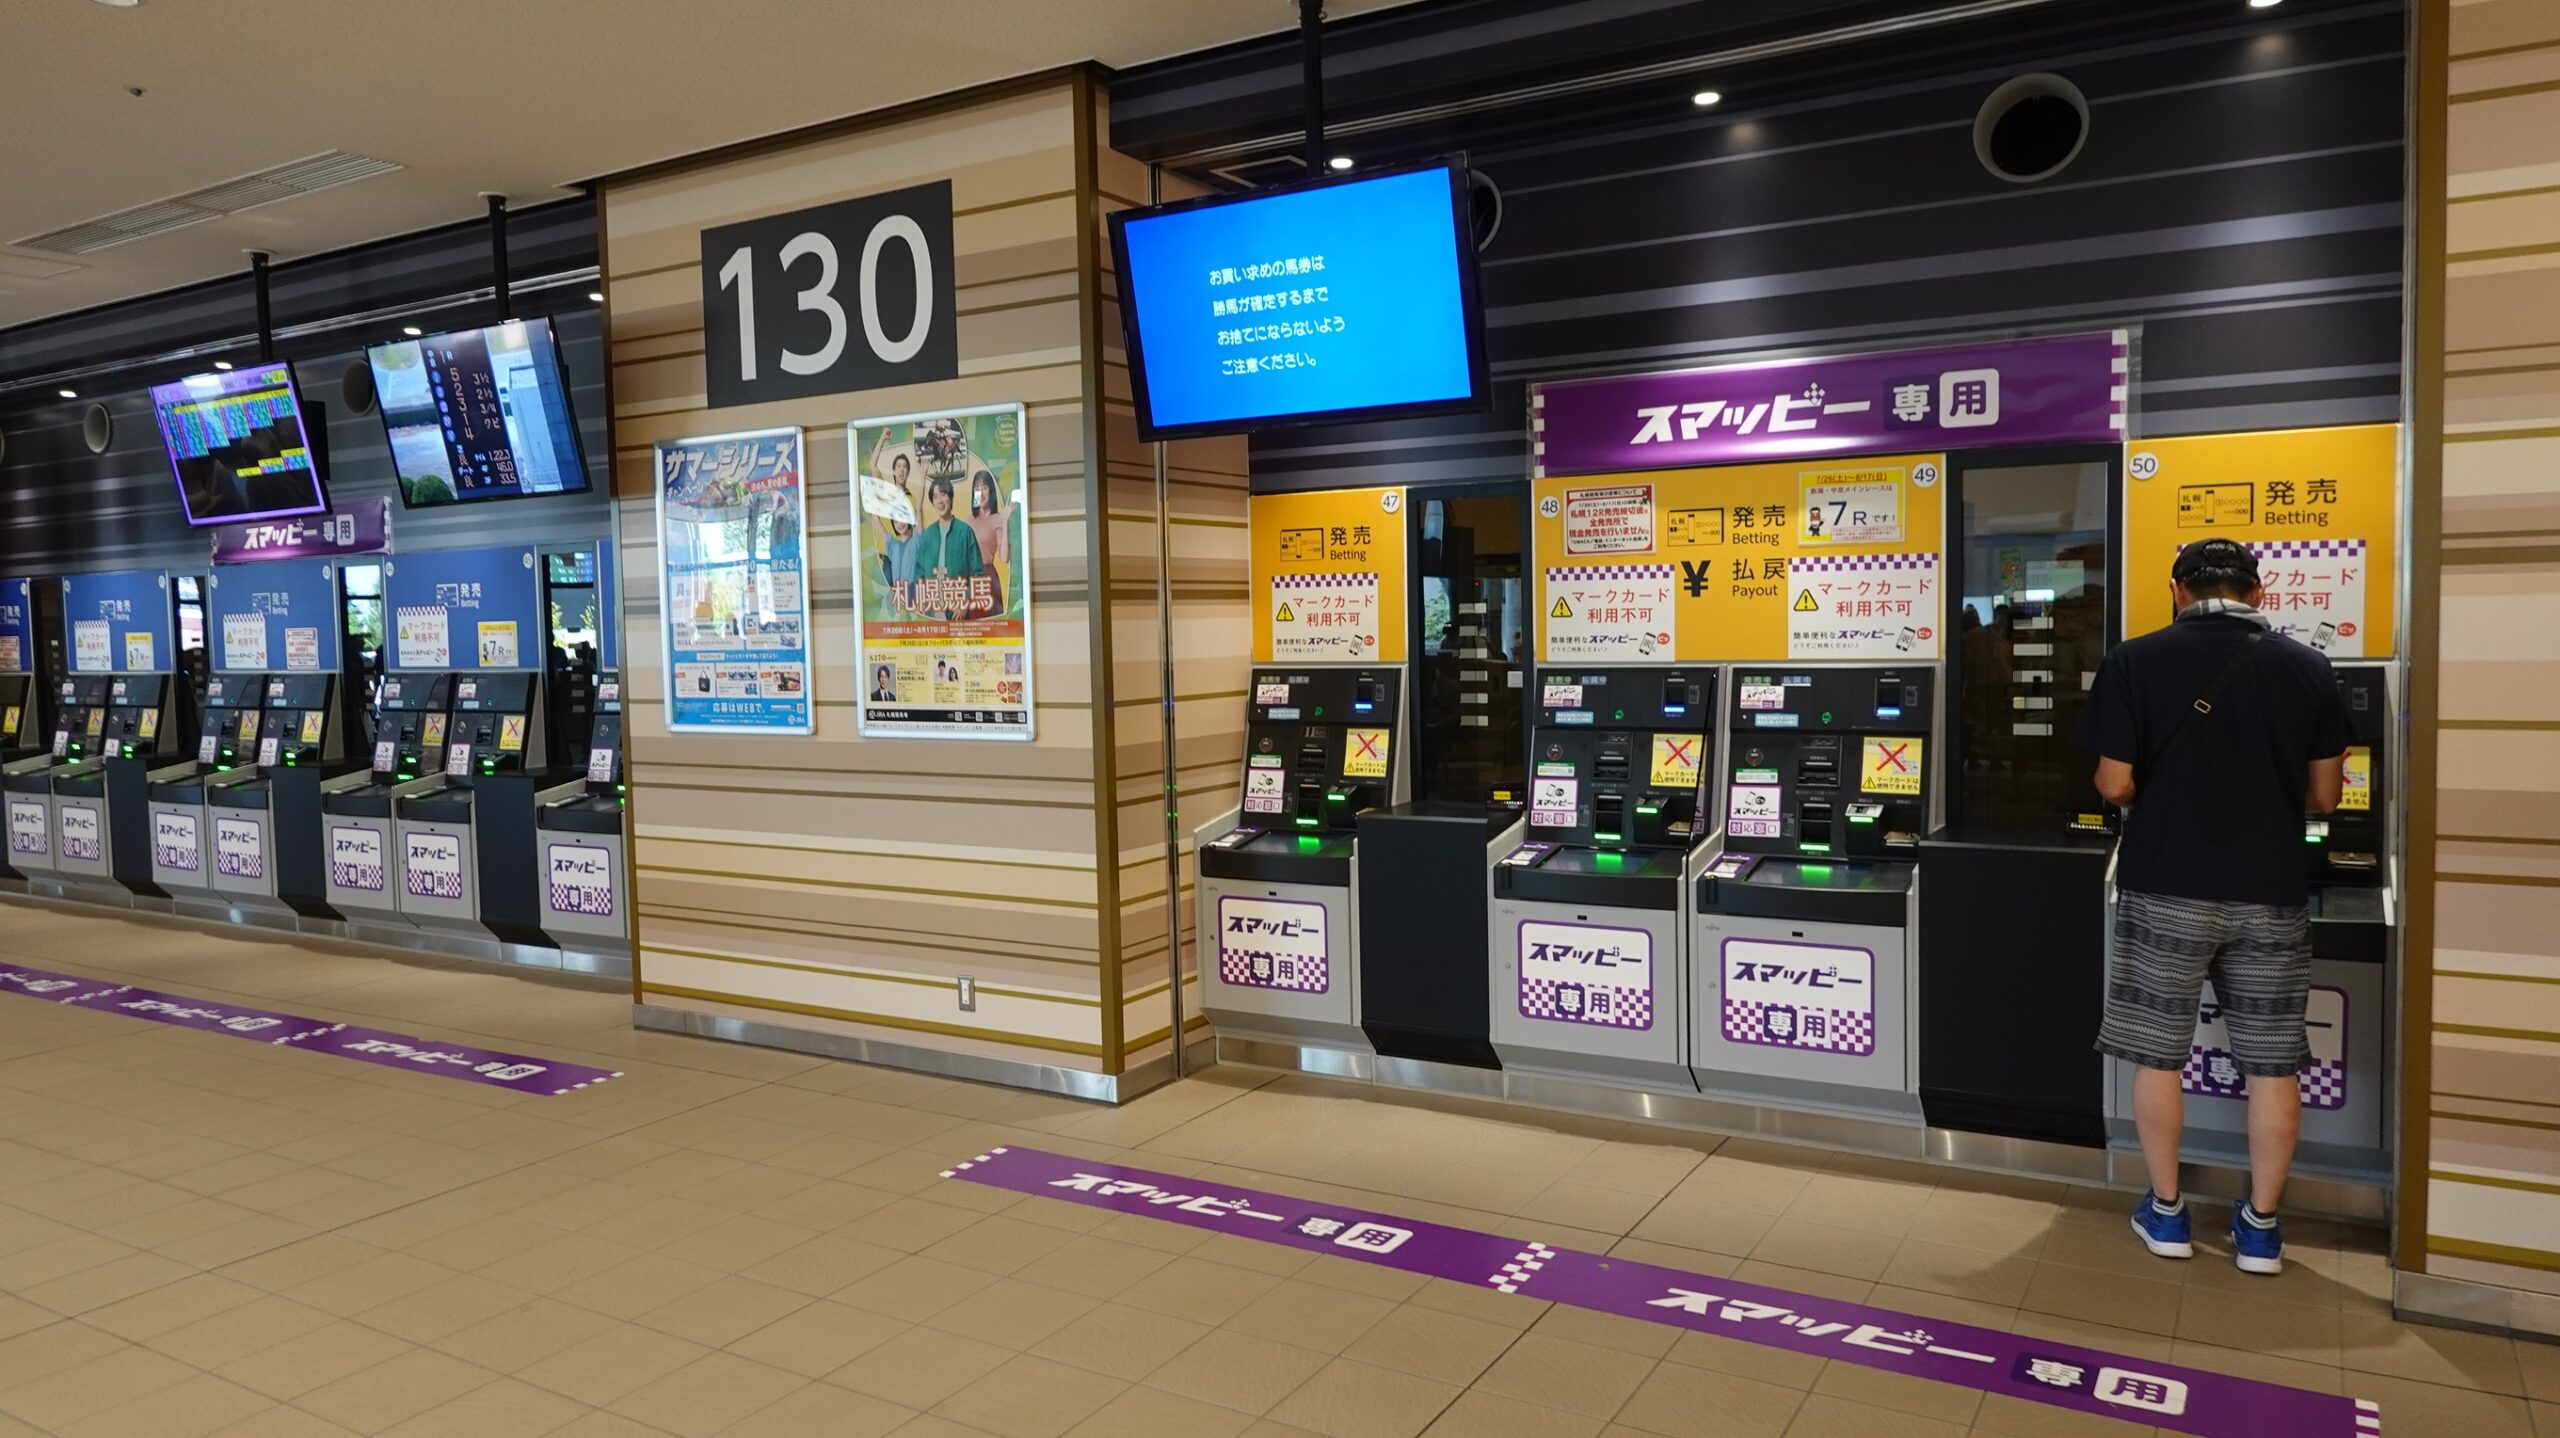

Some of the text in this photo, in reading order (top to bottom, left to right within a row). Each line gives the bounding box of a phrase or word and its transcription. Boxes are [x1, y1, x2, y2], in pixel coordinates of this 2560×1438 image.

[1209, 254, 1325, 286] お買い求めの馬券は
[719, 214, 933, 381] 130
[1213, 287, 1330, 317] 勝馬が確定するまで
[1217, 316, 1346, 346] お捨てにならないよう
[1221, 352, 1318, 376] ご注意ください。
[1630, 375, 1993, 446] スマッピー 専用
[666, 437, 796, 484] サマーシリーズ
[2132, 457, 2156, 474] 50
[1914, 469, 1936, 483] 49
[1383, 495, 1398, 508] 47
[2265, 478, 2337, 506] 発売
[1541, 500, 1558, 513] 48
[1732, 505, 1786, 528] 発売
[1828, 501, 1847, 526] 7
[1853, 511, 1867, 525] R
[2265, 510, 2329, 527] Betting
[243, 516, 353, 550] スマッピー 専用
[1330, 525, 1371, 546] 発売
[1732, 533, 1779, 546] Betting
[1330, 551, 1367, 562] Betting
[1732, 558, 1785, 581] 払戻
[2263, 568, 2358, 588] クカード
[460, 583, 482, 598] 発売
[891, 576, 994, 613] 札幌競馬
[1571, 588, 1670, 603] マークカード
[1732, 585, 1778, 599] Payout
[1818, 578, 1933, 596] マークカード
[1293, 595, 1375, 609] マークカード
[1836, 600, 1913, 617] 利用不可
[2260, 592, 2333, 611] 用不可
[1306, 613, 1361, 627] 利用不可
[1587, 608, 1653, 623] 利用不可
[489, 641, 497, 656] 7
[336, 840, 378, 854] スマッピー
[410, 846, 456, 861] スマッピー
[553, 860, 606, 875] スマッピー
[1227, 916, 1319, 937] スマッピー
[1528, 942, 1642, 968] スマッピー
[1253, 956, 1294, 980] 専用
[1732, 960, 1863, 988] スマッピー
[1559, 989, 1611, 1015] 専用
[1767, 1010, 1826, 1040] 専用
[343, 1039, 472, 1066] スマッピー
[2208, 1055, 2240, 1086] 専
[1047, 1172, 1408, 1253] スマッピー 専用
[1645, 1287, 2176, 1408] スマッピー 専用
